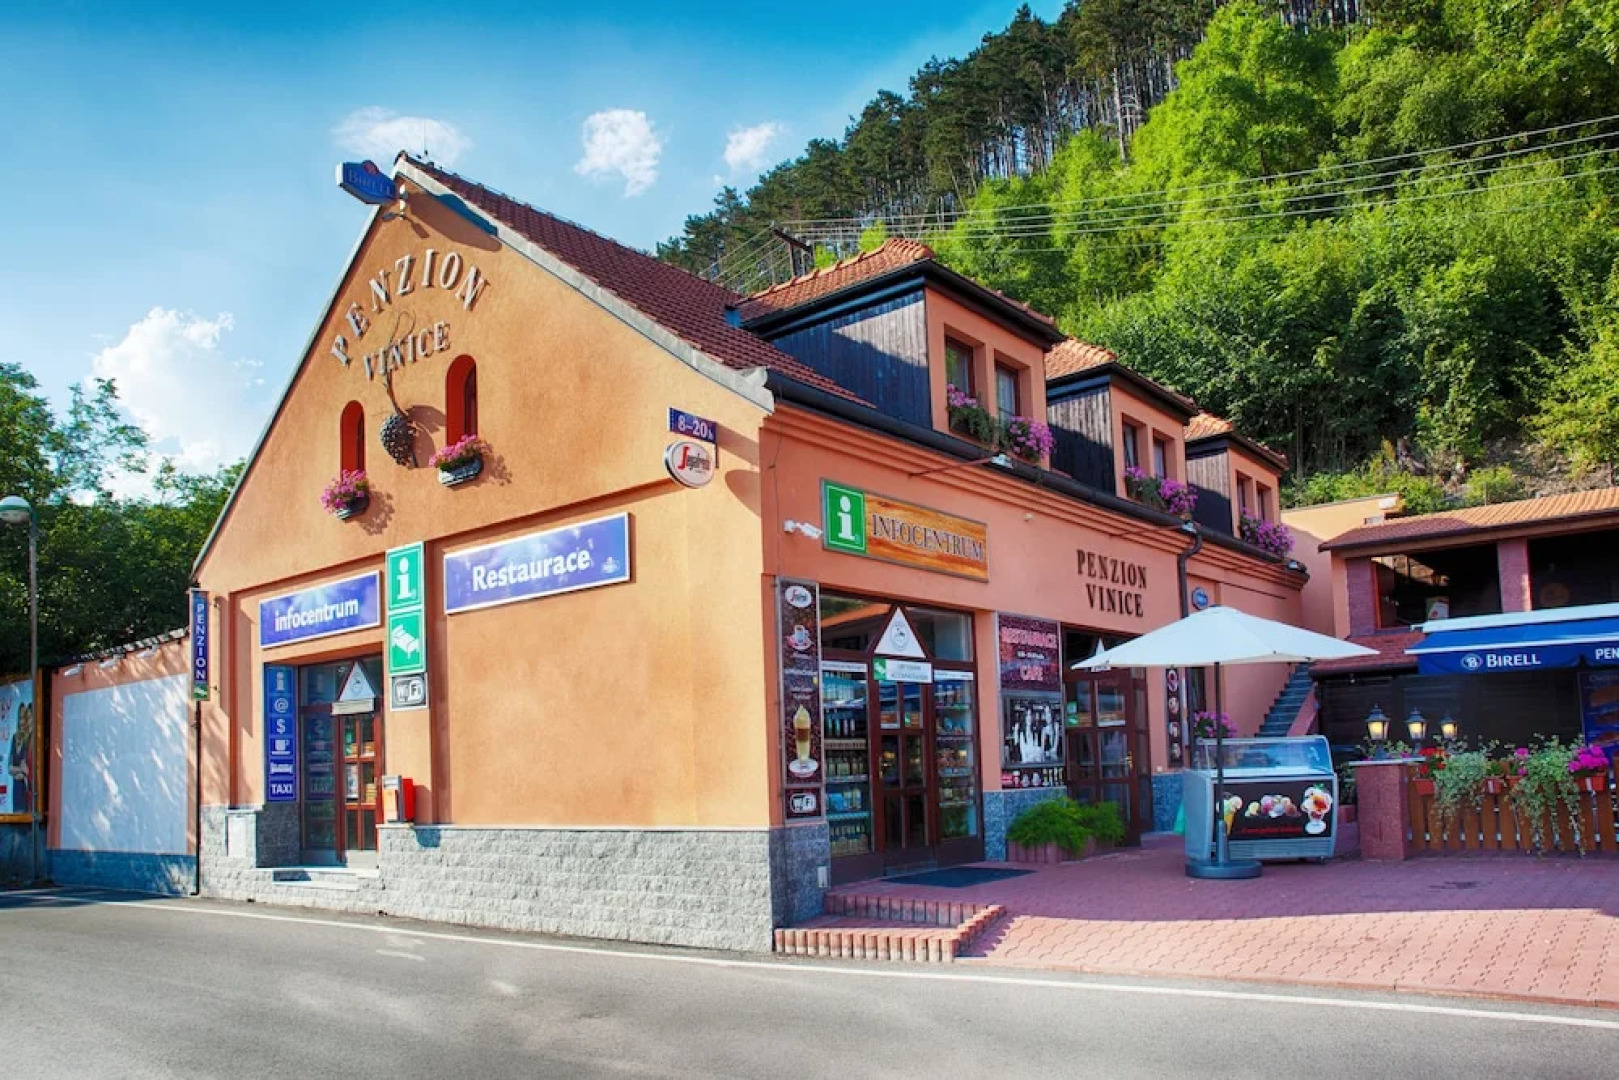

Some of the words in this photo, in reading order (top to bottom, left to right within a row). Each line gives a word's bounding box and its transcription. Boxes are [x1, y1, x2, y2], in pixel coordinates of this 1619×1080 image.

[330, 248, 487, 368] PENZION
[363, 319, 449, 381] VINICE
[871, 514, 985, 561] INFOCENTRUM
[472, 548, 591, 592] Restaurace
[1076, 549, 1147, 589] PENZION
[274, 598, 359, 633] infocentrum
[1085, 582, 1144, 618] VINICE
[195, 603, 207, 680] PENZION
[1486, 653, 1542, 668] BIRELL
[271, 783, 293, 795] TAXI
